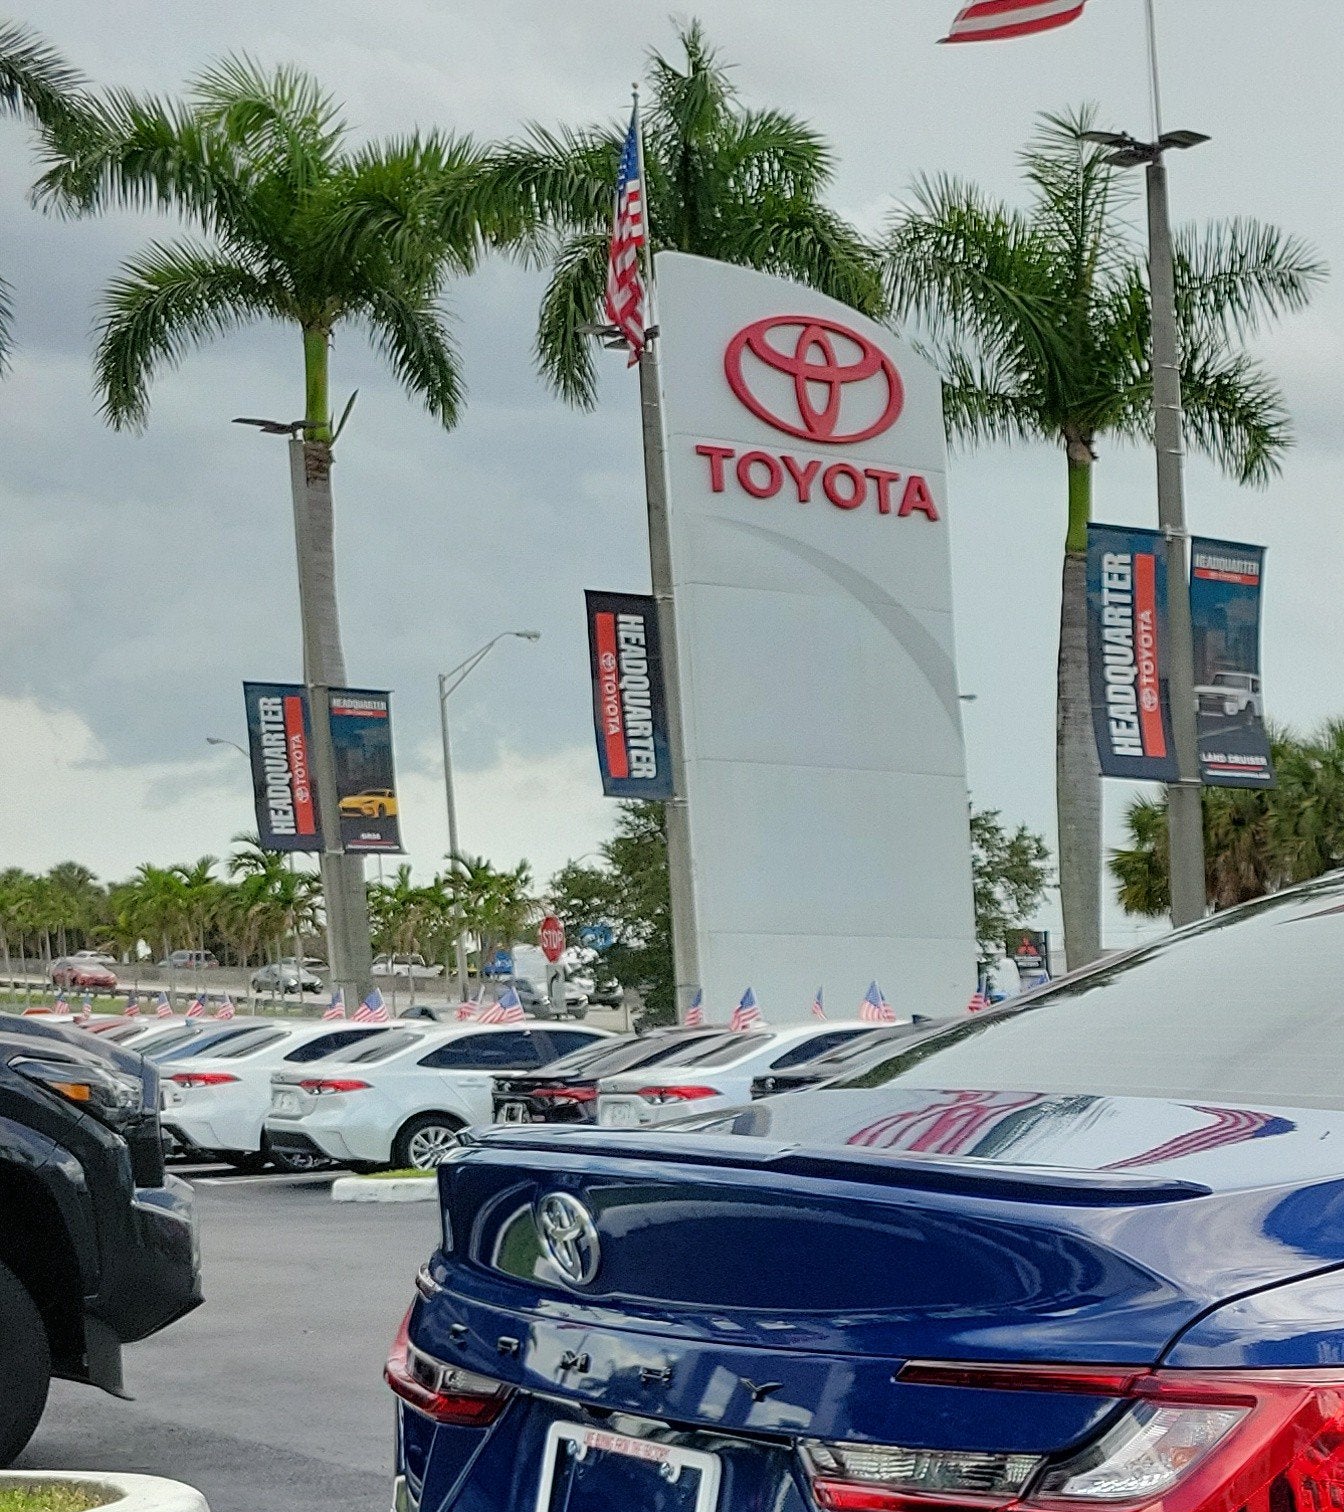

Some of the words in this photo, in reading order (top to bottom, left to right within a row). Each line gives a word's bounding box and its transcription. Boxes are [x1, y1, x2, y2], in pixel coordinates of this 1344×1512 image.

[695, 445, 939, 522] TOYOTA
[1103, 551, 1144, 757] HEADQUARTER
[1137, 610, 1156, 685] TOYOTA
[602, 674, 620, 735] TOYOTA
[617, 613, 657, 779] HEADQUARTER
[259, 697, 297, 835] HEADQUARTER
[290, 733, 306, 786] TOYOTA
[542, 929, 563, 949] STOP
